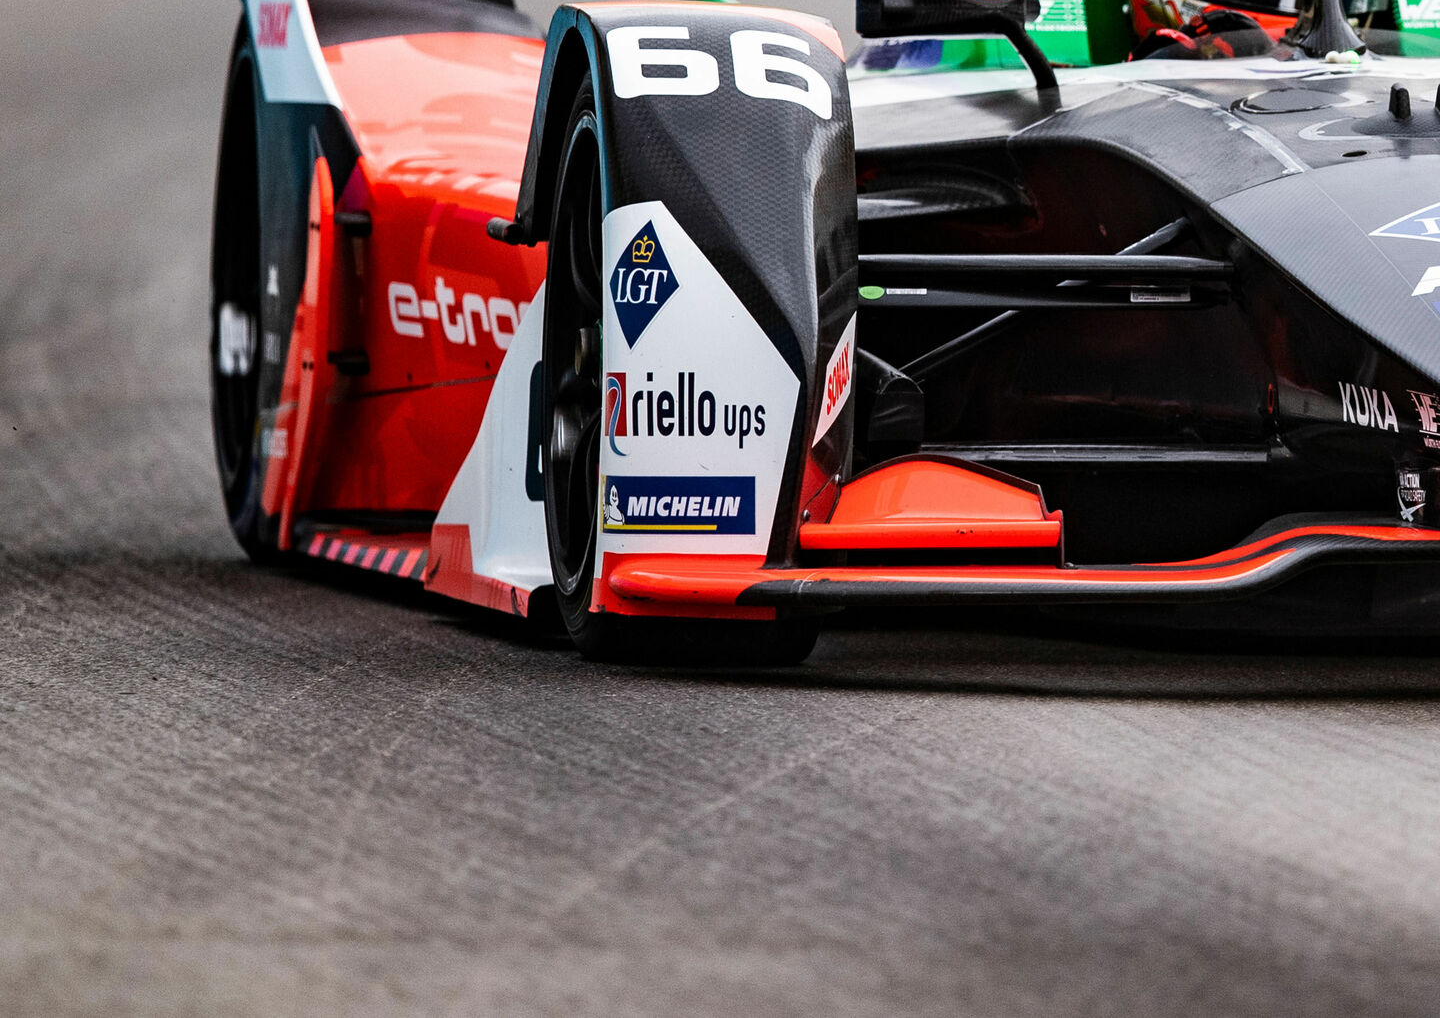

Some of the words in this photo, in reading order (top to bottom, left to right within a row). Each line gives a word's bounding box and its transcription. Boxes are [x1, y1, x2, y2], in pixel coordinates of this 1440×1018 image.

[605, 25, 833, 120] 66
[615, 268, 668, 304] LGT
[632, 372, 716, 437] riello
[724, 404, 766, 449] ups
[826, 342, 850, 416] SONAX
[1338, 381, 1399, 433] KUKA
[627, 495, 741, 517] MICHELIN
